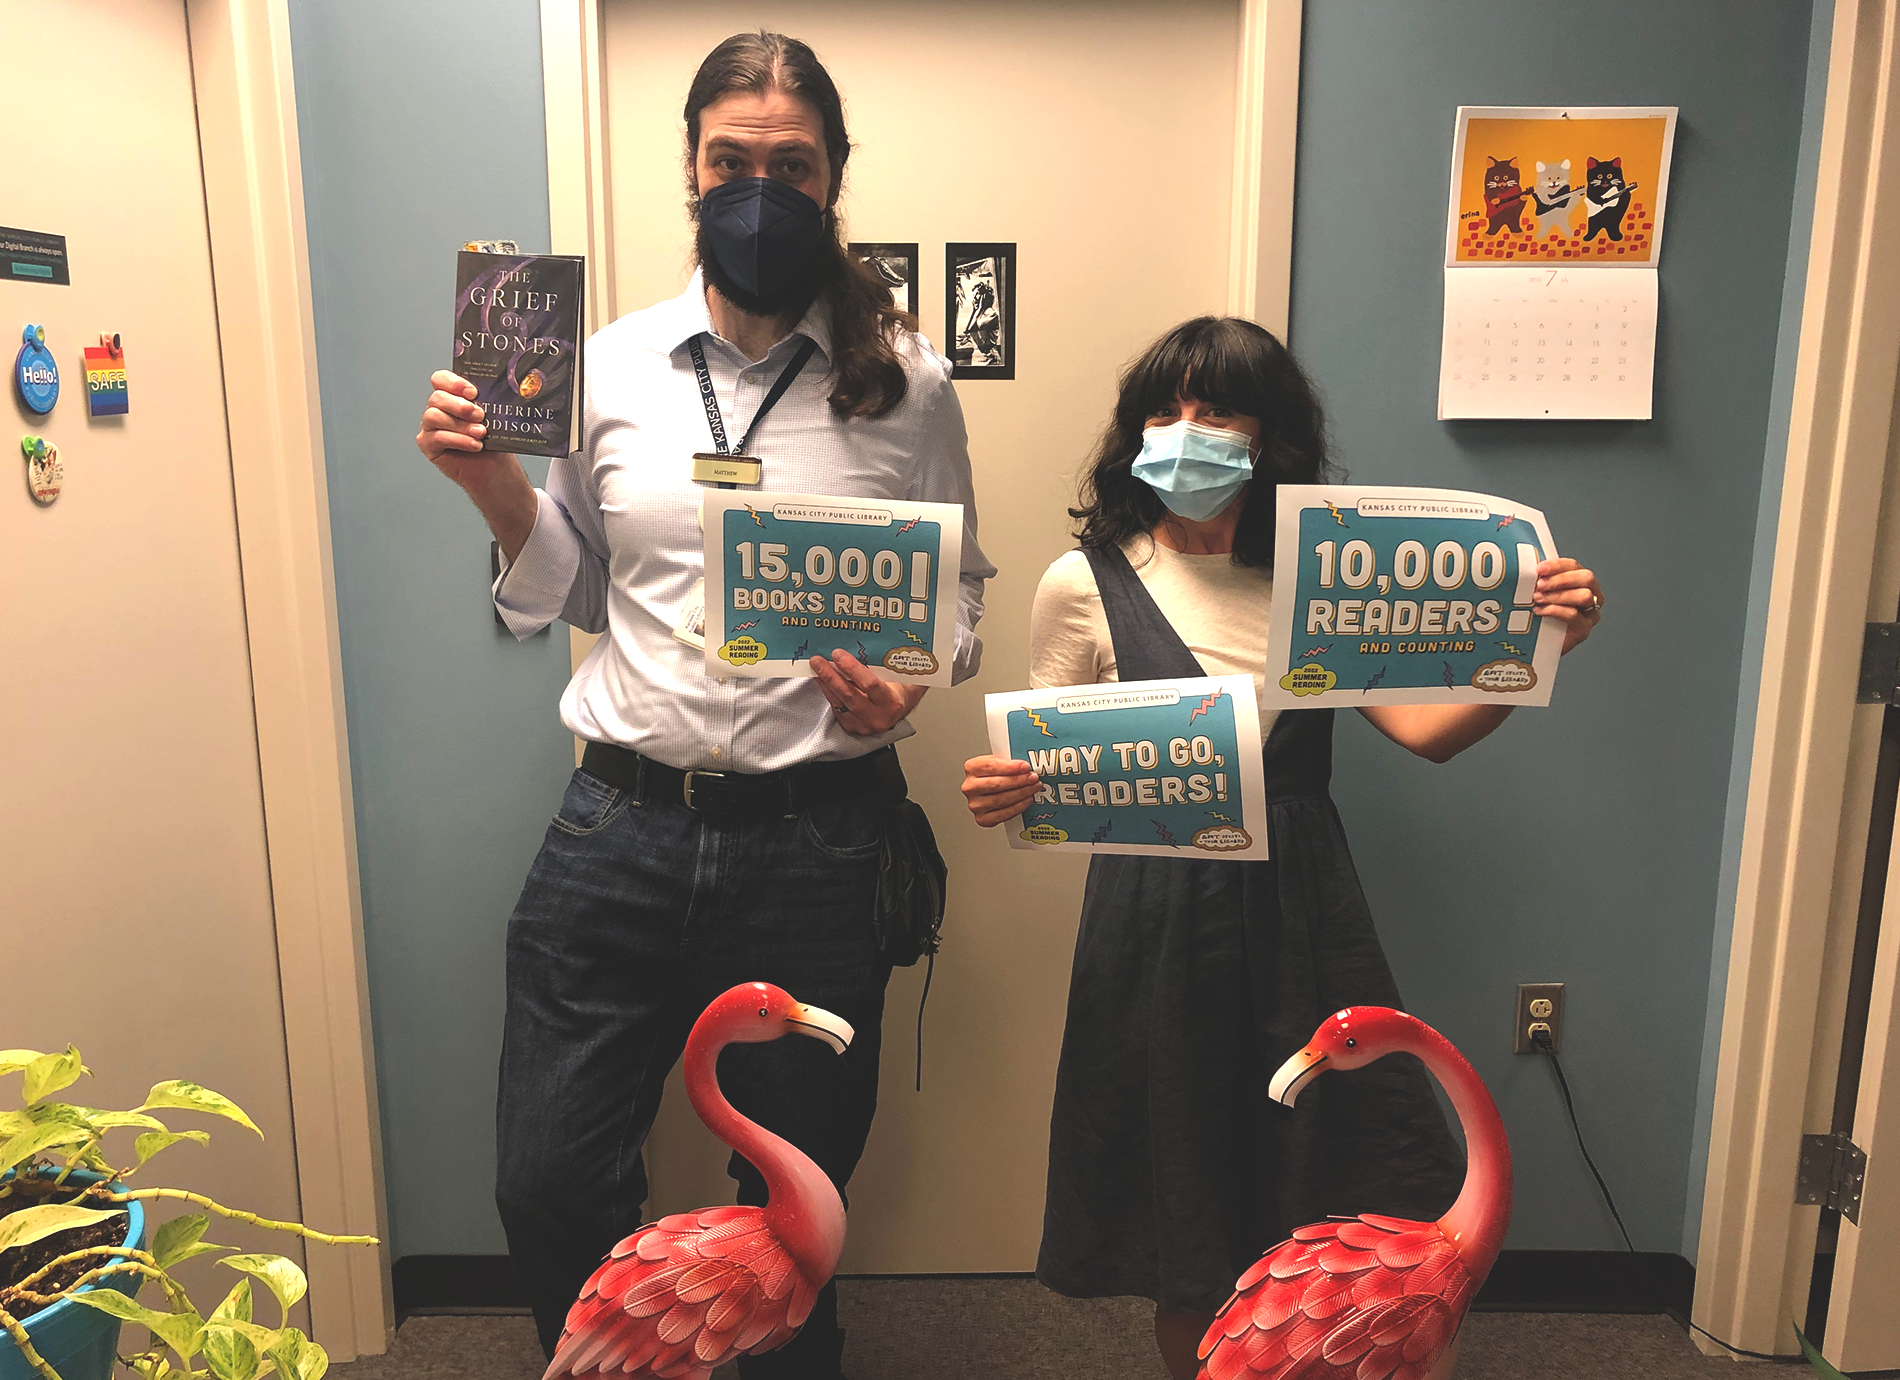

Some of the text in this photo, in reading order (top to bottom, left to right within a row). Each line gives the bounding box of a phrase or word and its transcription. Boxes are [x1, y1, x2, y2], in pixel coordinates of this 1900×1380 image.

[1460, 210, 1480, 220] erina
[20, 243, 33, 252] Branch
[499, 270, 531, 284] THE
[1546, 270, 1558, 287] 7
[470, 286, 558, 312] GRIEF
[1622, 305, 1628, 313] 2
[502, 315, 522, 328] OF
[1538, 322, 1545, 330] 6
[1594, 322, 1600, 330] 8
[1621, 322, 1627, 330] 9
[461, 331, 560, 356] STONES
[1511, 339, 1519, 347] 12
[1538, 339, 1546, 347] 13
[1565, 339, 1573, 347] 14
[1563, 357, 1572, 365] 21
[1591, 357, 1599, 365] 22
[1618, 357, 1627, 365] 23
[91, 372, 125, 391] SAFE
[696, 368, 712, 394] CITY
[1481, 373, 1490, 381] 25
[1562, 374, 1572, 382] 28
[1590, 374, 1599, 382] 29
[481, 402, 555, 420] THERINE
[704, 396, 725, 444] KANSAS
[777, 508, 807, 517] KANSAS
[828, 512, 855, 520] PUBLIC
[857, 513, 888, 522] LIBRARY
[1361, 504, 1484, 515] KANSAS CITY PUBLIC LIBRARY
[732, 586, 825, 613] BOOKS
[782, 616, 882, 633] AND COUNTING
[1359, 640, 1475, 655] AND COUNTING
[1292, 673, 1328, 681] SUMMER
[1292, 681, 1326, 689] READING
[1060, 700, 1091, 709] KANSAS
[1113, 696, 1140, 704] PUBLIC
[1142, 693, 1175, 702] LIBRARY
[1027, 734, 1225, 777] WAY TO GO,
[1033, 772, 1228, 807] READERS!
